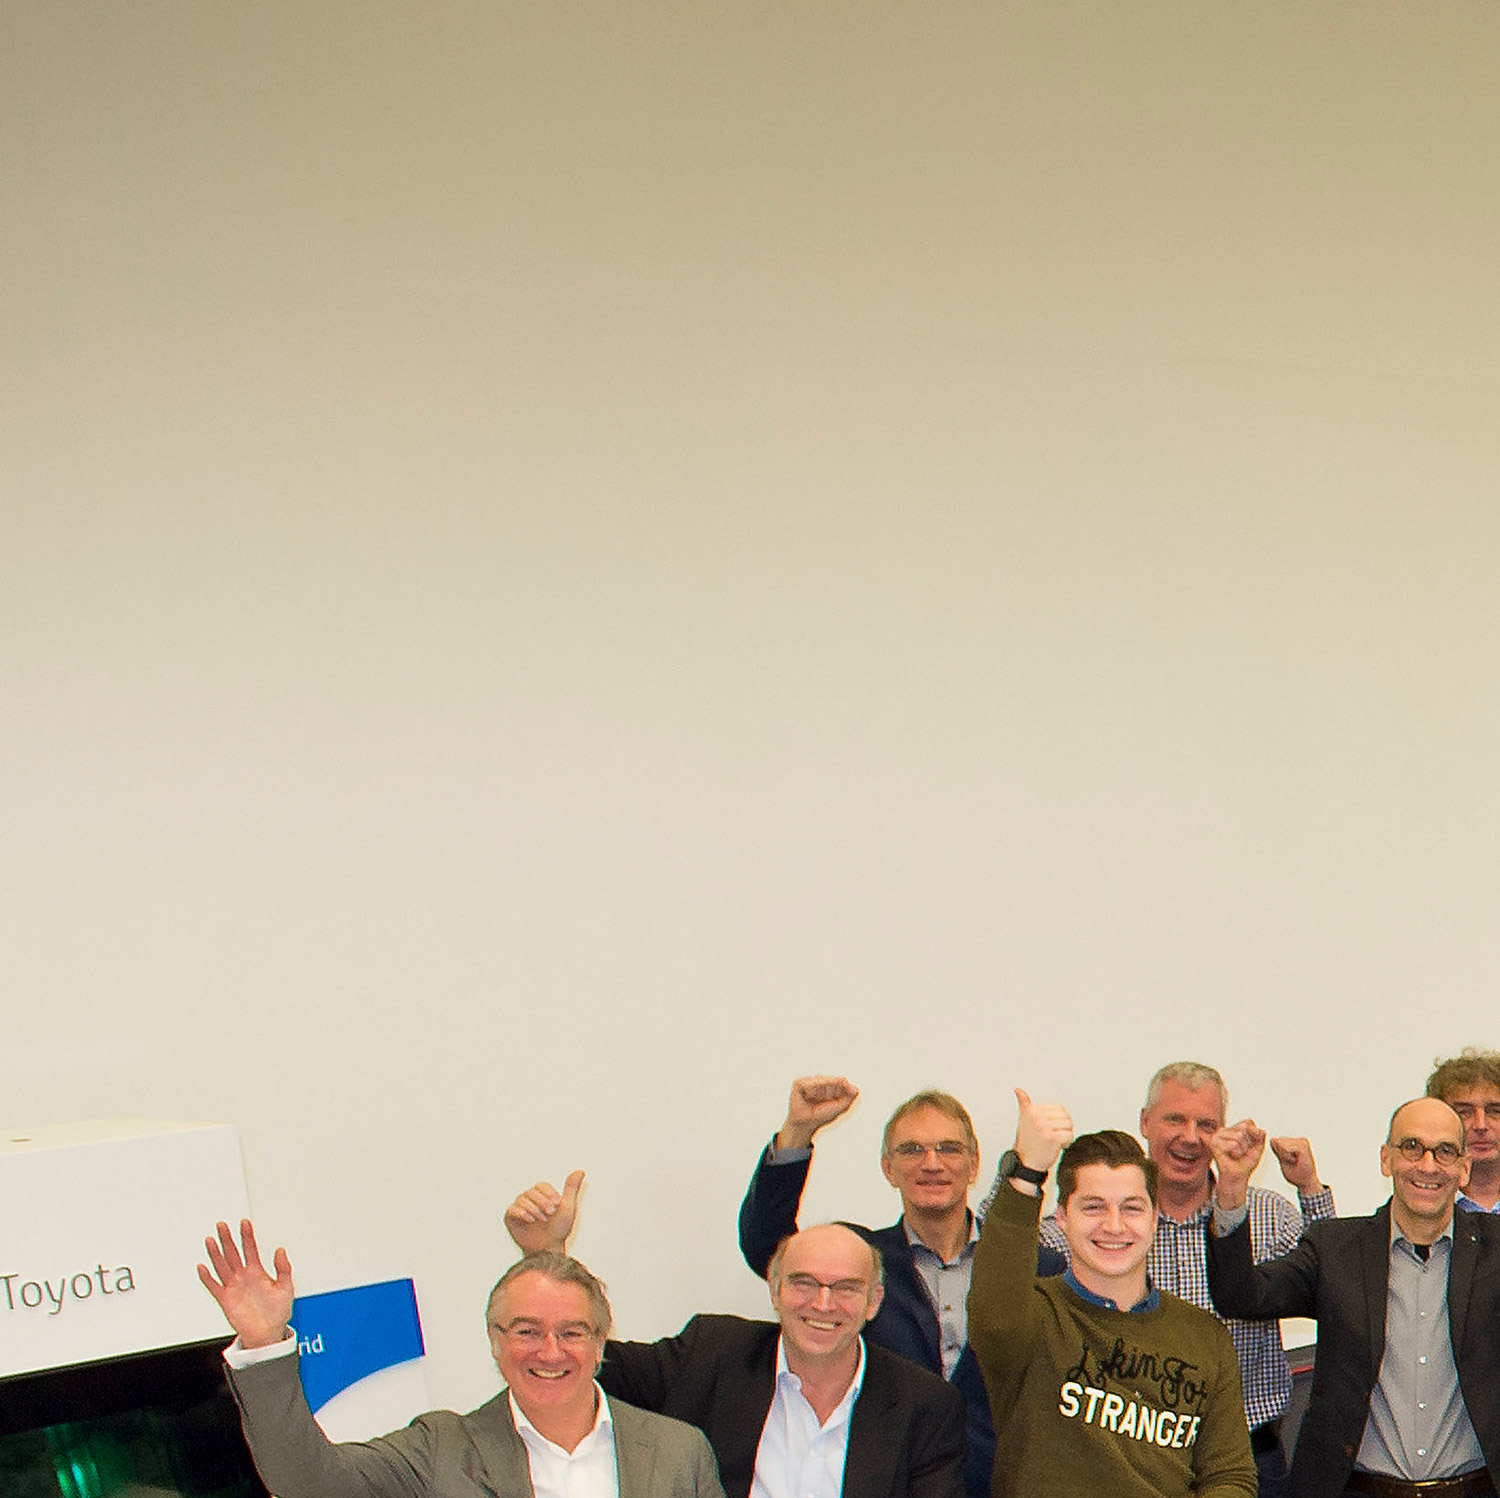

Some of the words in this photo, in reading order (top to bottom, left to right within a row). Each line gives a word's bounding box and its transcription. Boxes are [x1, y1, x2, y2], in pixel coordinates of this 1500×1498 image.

[0, 1263, 136, 1316] Toyota
[297, 1333, 324, 1357] rid
[1058, 1380, 1201, 1449] STRANGER
